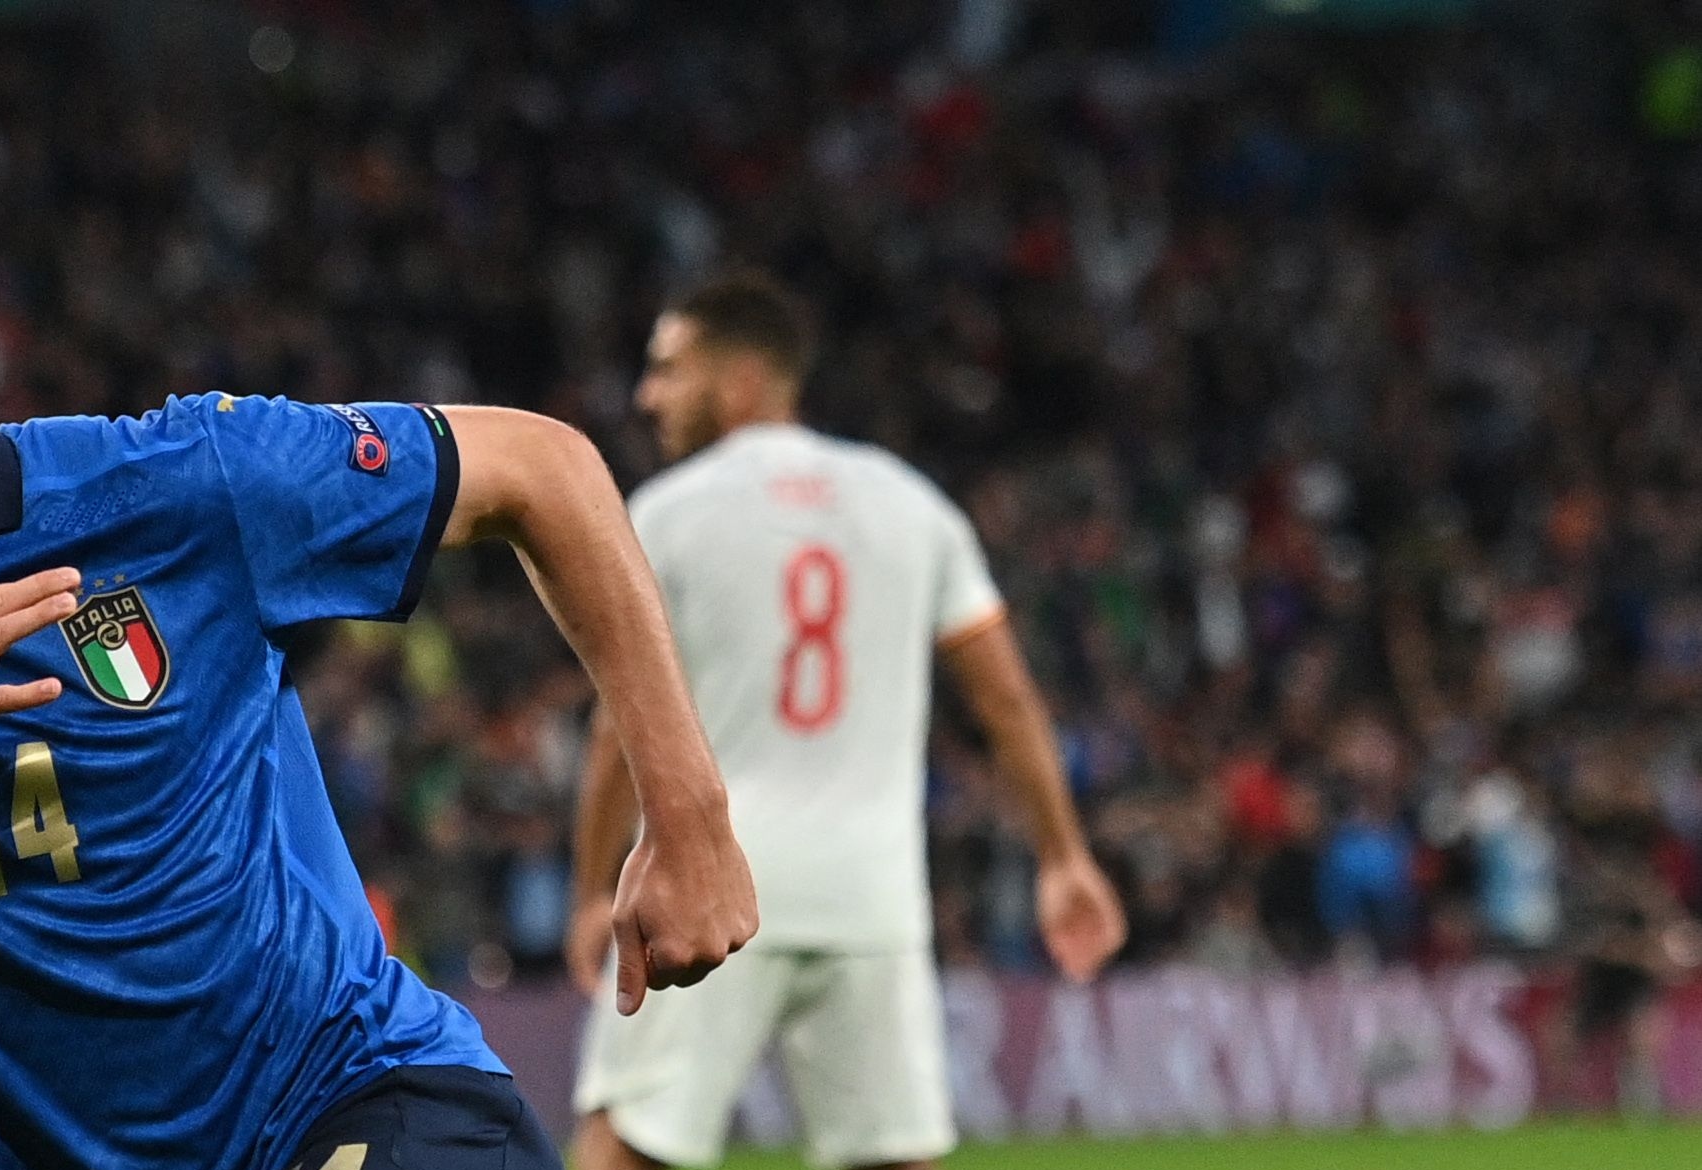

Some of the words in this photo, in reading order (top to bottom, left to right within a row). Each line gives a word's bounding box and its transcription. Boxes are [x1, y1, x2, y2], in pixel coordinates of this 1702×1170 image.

[331, 404, 373, 433] RES
[69, 597, 136, 638] ITALIA
[779, 540, 848, 738] 8
